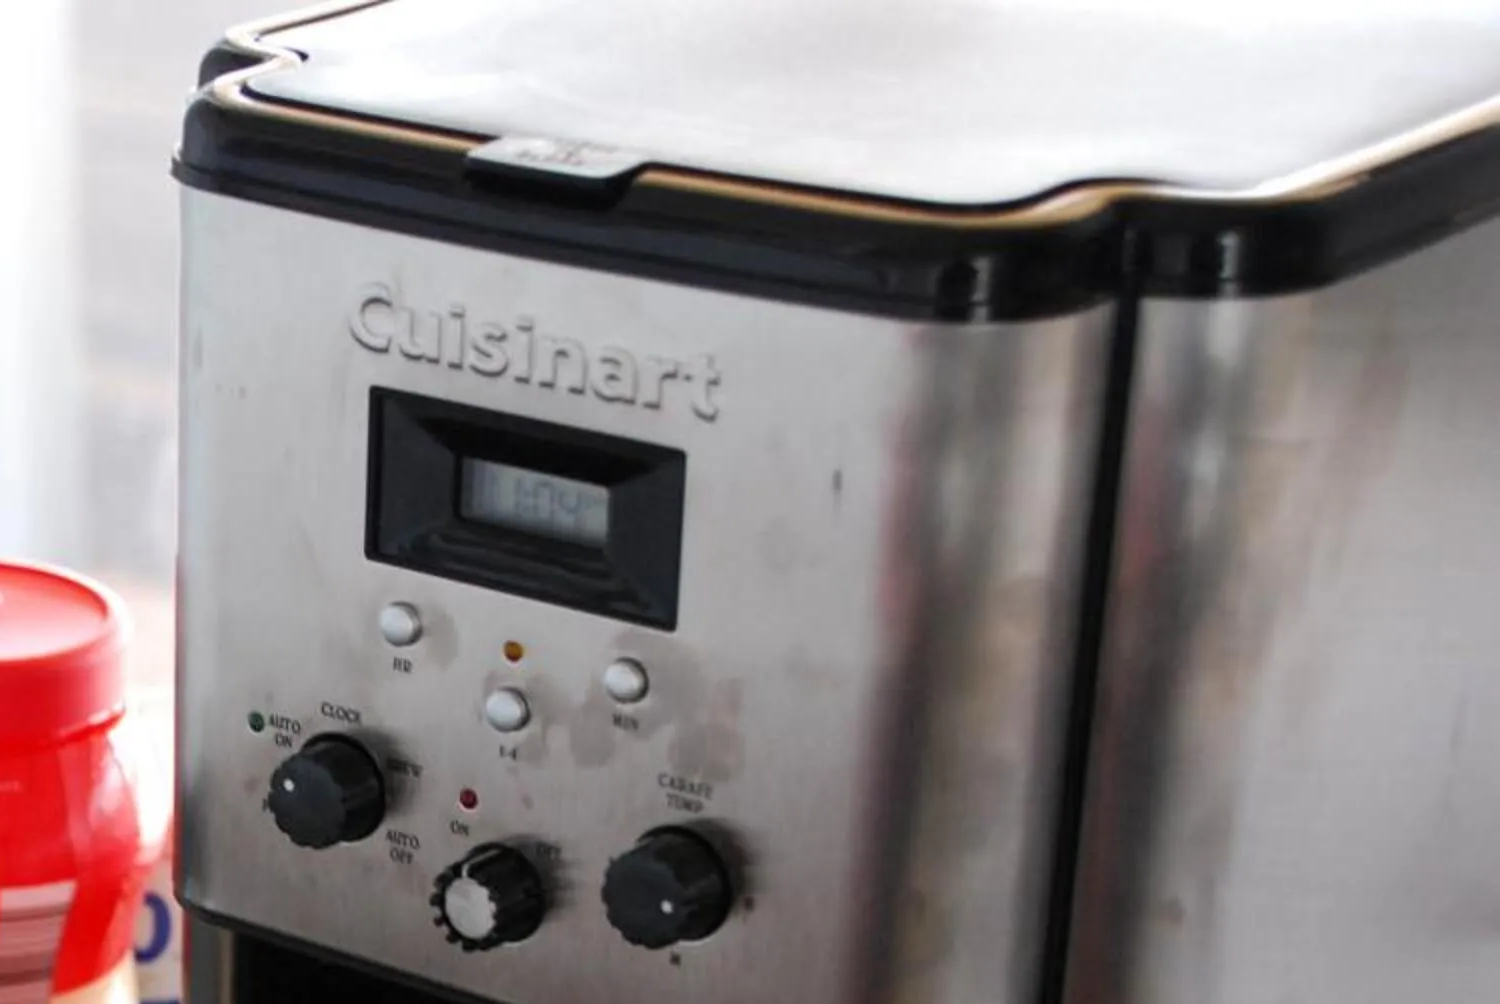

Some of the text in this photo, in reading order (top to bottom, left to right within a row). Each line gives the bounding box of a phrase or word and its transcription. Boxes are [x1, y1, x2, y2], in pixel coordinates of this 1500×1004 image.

[350, 283, 722, 423] Cuisinart
[321, 702, 361, 725] CLOCK
[269, 714, 301, 734] AUTO
[275, 733, 293, 749] ON
[451, 819, 470, 838] ON
[386, 829, 421, 850] AUTO
[389, 847, 415, 865] OFF
